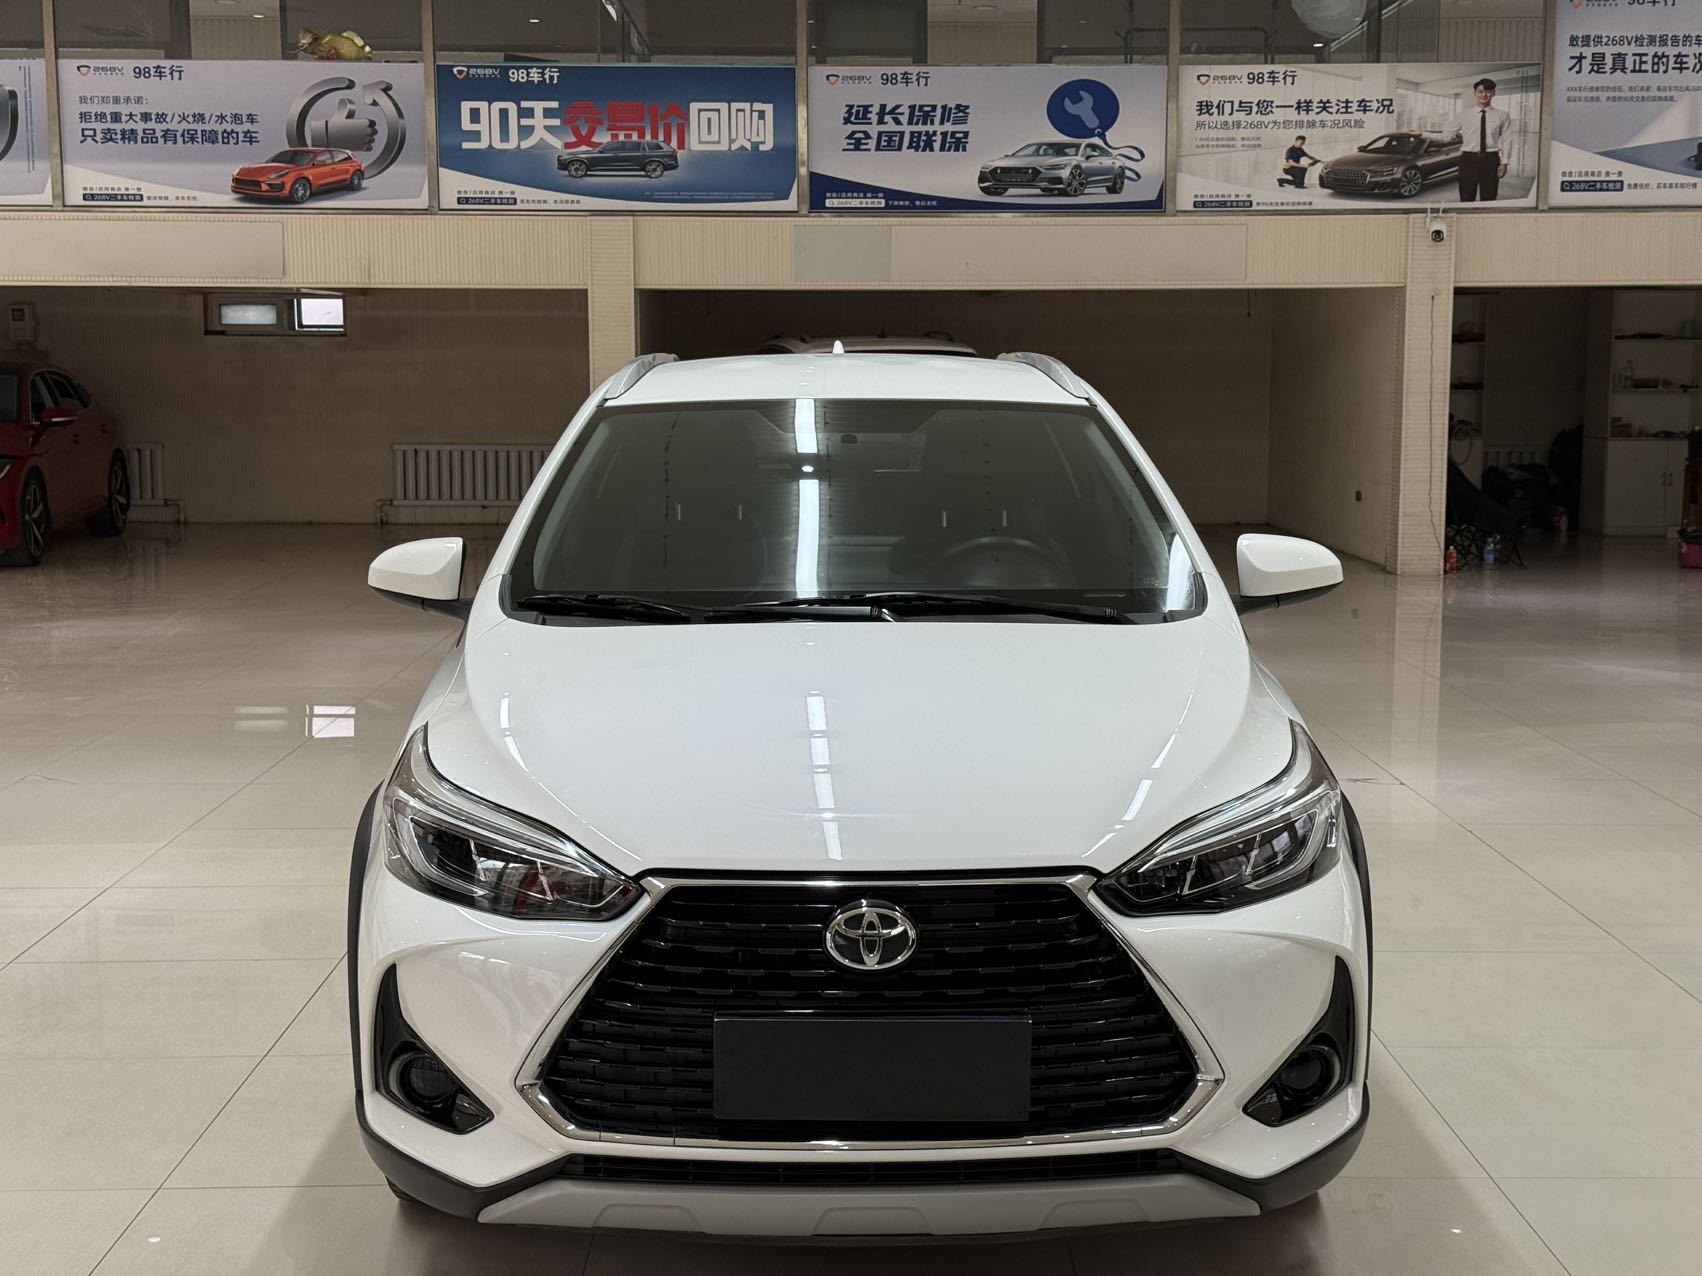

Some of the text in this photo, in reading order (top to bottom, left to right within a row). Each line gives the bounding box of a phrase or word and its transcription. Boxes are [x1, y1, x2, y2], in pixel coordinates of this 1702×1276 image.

[133, 65, 185, 81] 98车行
[508, 67, 560, 84] 98车行
[880, 71, 931, 87] 98车行
[1247, 70, 1298, 86] 98车行
[842, 103, 971, 126] 延长保修
[1196, 98, 1395, 117] 我们与您一样关注车况
[79, 111, 260, 126] 拒绝重大事故/火烧/水泡车
[460, 100, 775, 151] 90天交易价回购
[1195, 118, 1366, 132] 所以选择268V为您排除车况风险
[79, 128, 261, 146] 只卖精品有保障的车
[842, 130, 971, 153] 全国联保
